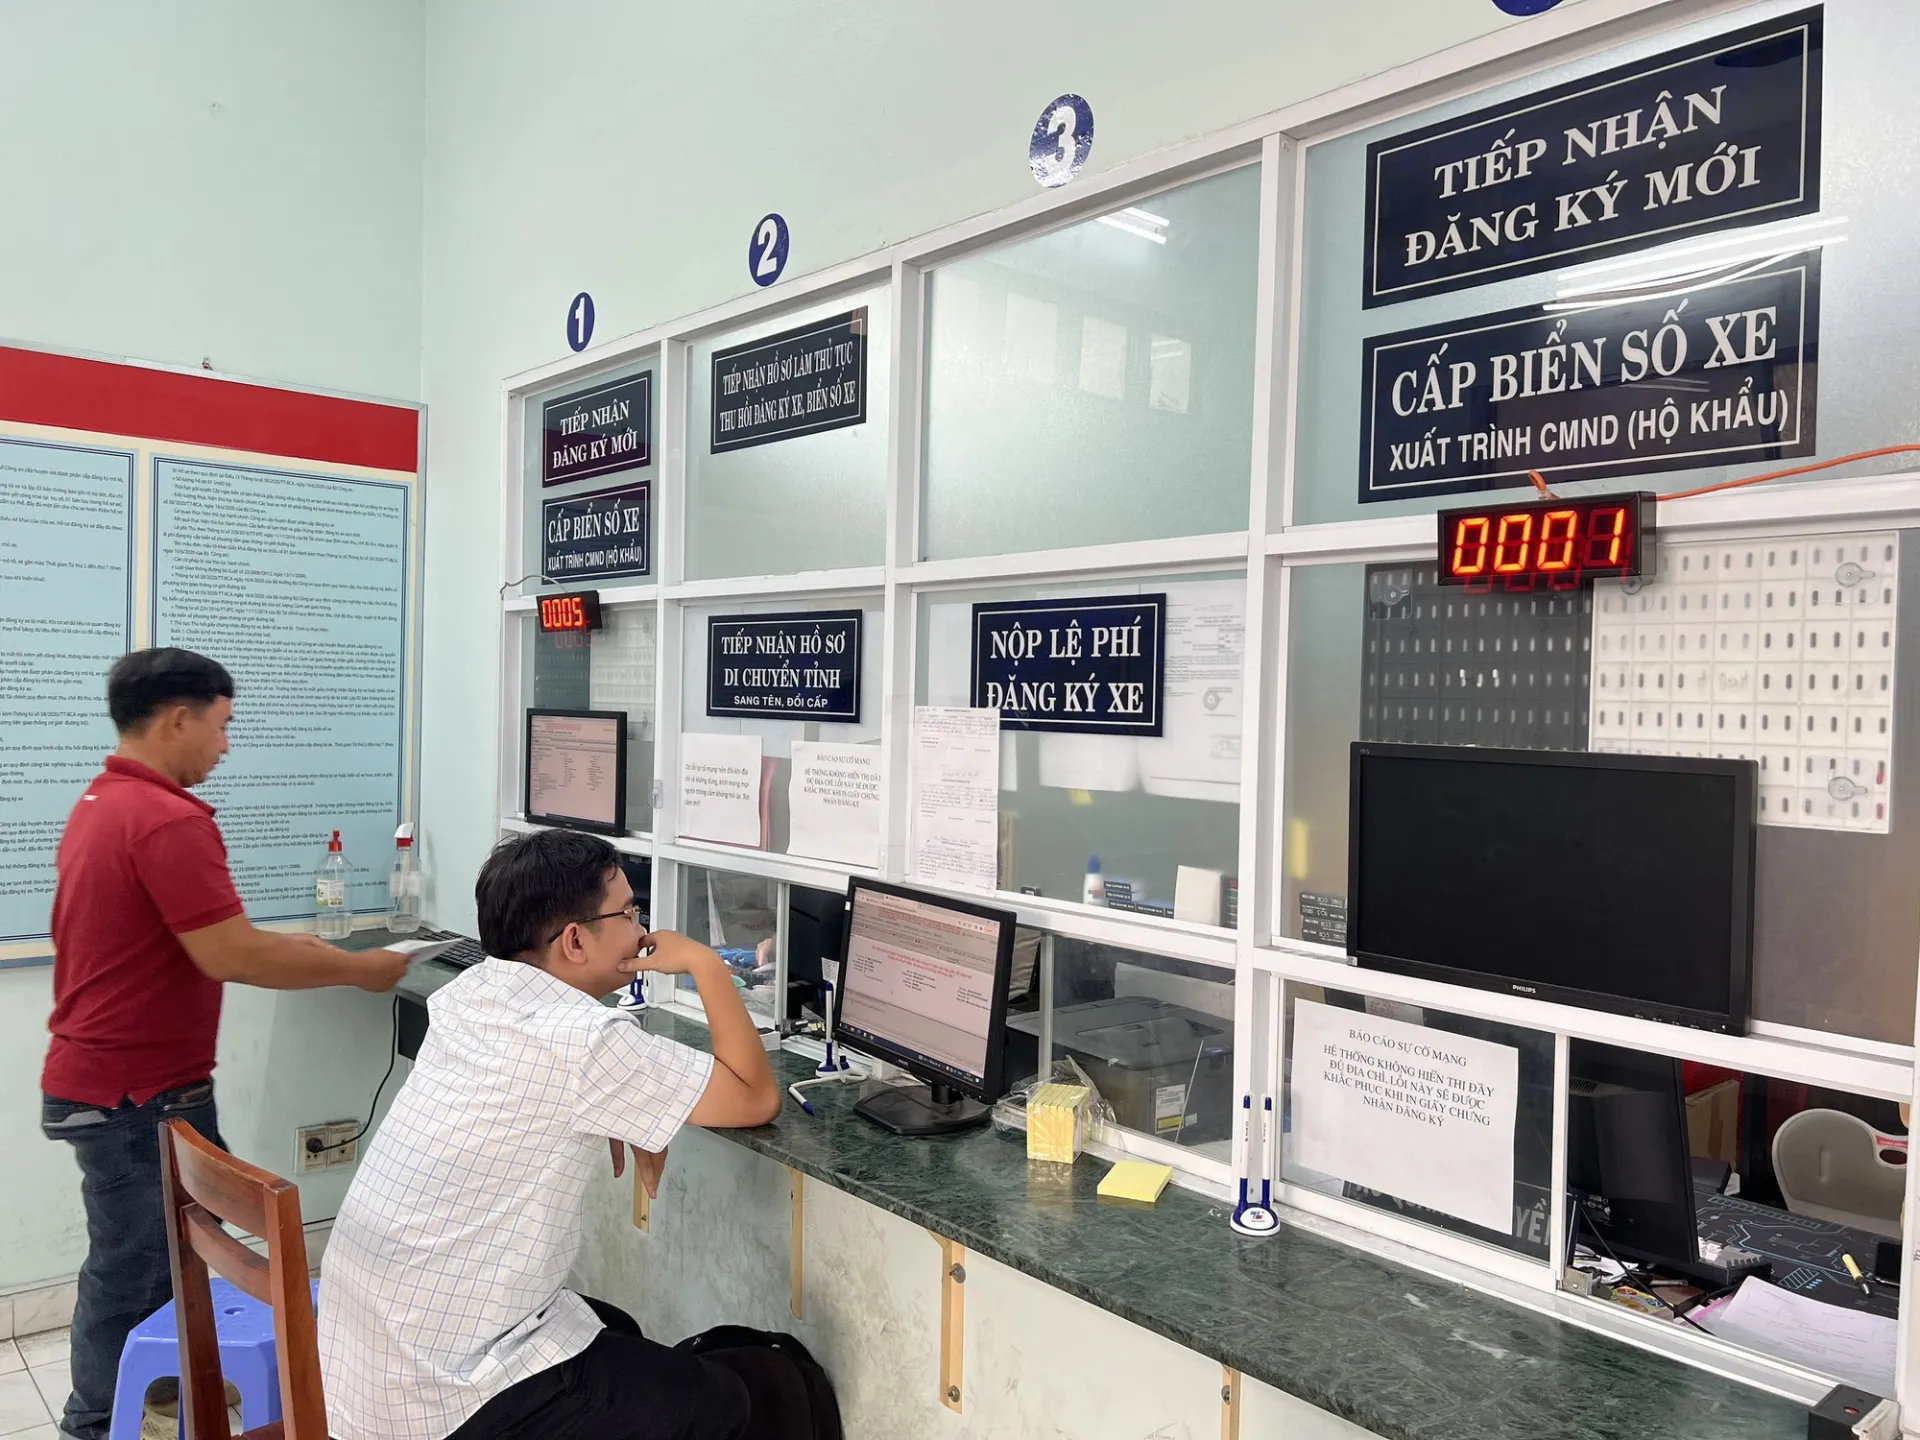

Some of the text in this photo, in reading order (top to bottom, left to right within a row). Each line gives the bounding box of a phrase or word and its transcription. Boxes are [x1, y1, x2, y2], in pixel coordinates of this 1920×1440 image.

[1047, 106, 1076, 173] 3
[1434, 85, 1727, 199] TIẾP NHẬN
[1404, 141, 1762, 266] ĐĂNG KÝ MỚI
[757, 219, 777, 277] 2
[574, 298, 585, 343] 1
[723, 338, 853, 395] TIẾP NHẬN HỒ SƠ LÀM THỦ TỤC
[1391, 299, 1777, 416] CẤP BIỂN SỐ XE
[560, 398, 630, 436] TIẾP NHẬN
[720, 373, 855, 432] THU HỒI ĐĂNG KÝ XE, BIỂN SỐ XE
[1389, 376, 1788, 471] XUẤT TRÌNH CMND (HỘ KHẨU)
[553, 427, 637, 468] ĐĂNG KÝ MỚI
[549, 498, 639, 543] CẤP BIỂN SỐ XE
[1453, 509, 1624, 575] 0001
[548, 539, 642, 571] XUẤT TRÌNH CMND (HỘ KHẨU)
[542, 597, 583, 627] 0005
[722, 625, 846, 658] TIẾP NHẬN HỒ SƠ
[990, 615, 1141, 666] NỘP LỆ PHÍ
[724, 659, 840, 688] DI CHUYỂN TỈNH
[986, 672, 1143, 713] ĐĂNG KÝ XE
[734, 693, 828, 708] SANG TÊN, ĐỔI CẤP
[1512, 984, 1536, 994] PHILIPS
[1350, 1029, 1466, 1066] BÁO CÁO SỰ CỐ MẠNG
[1324, 1045, 1494, 1097] HỆ THỐNG KHÔNG HIỂN THỊ ĐẦY
[1324, 1071, 1352, 1086] KHẮC
[1355, 1080, 1382, 1095] PHỤC
[1385, 1088, 1403, 1101] KHI
[1406, 1094, 1417, 1105] IN
[1419, 1098, 1446, 1114] GIẤY
[1330, 1059, 1344, 1071] ĐỦ
[1347, 1064, 1364, 1077] ĐỊA
[1390, 1074, 1407, 1088] LỖI
[1411, 1081, 1433, 1096] NÀY
[1436, 1088, 1449, 1100] SẼ
[1452, 1093, 1485, 1110] ĐƯỢC
[1363, 1095, 1444, 1127] NHẬN ĐĂNG KÝ
